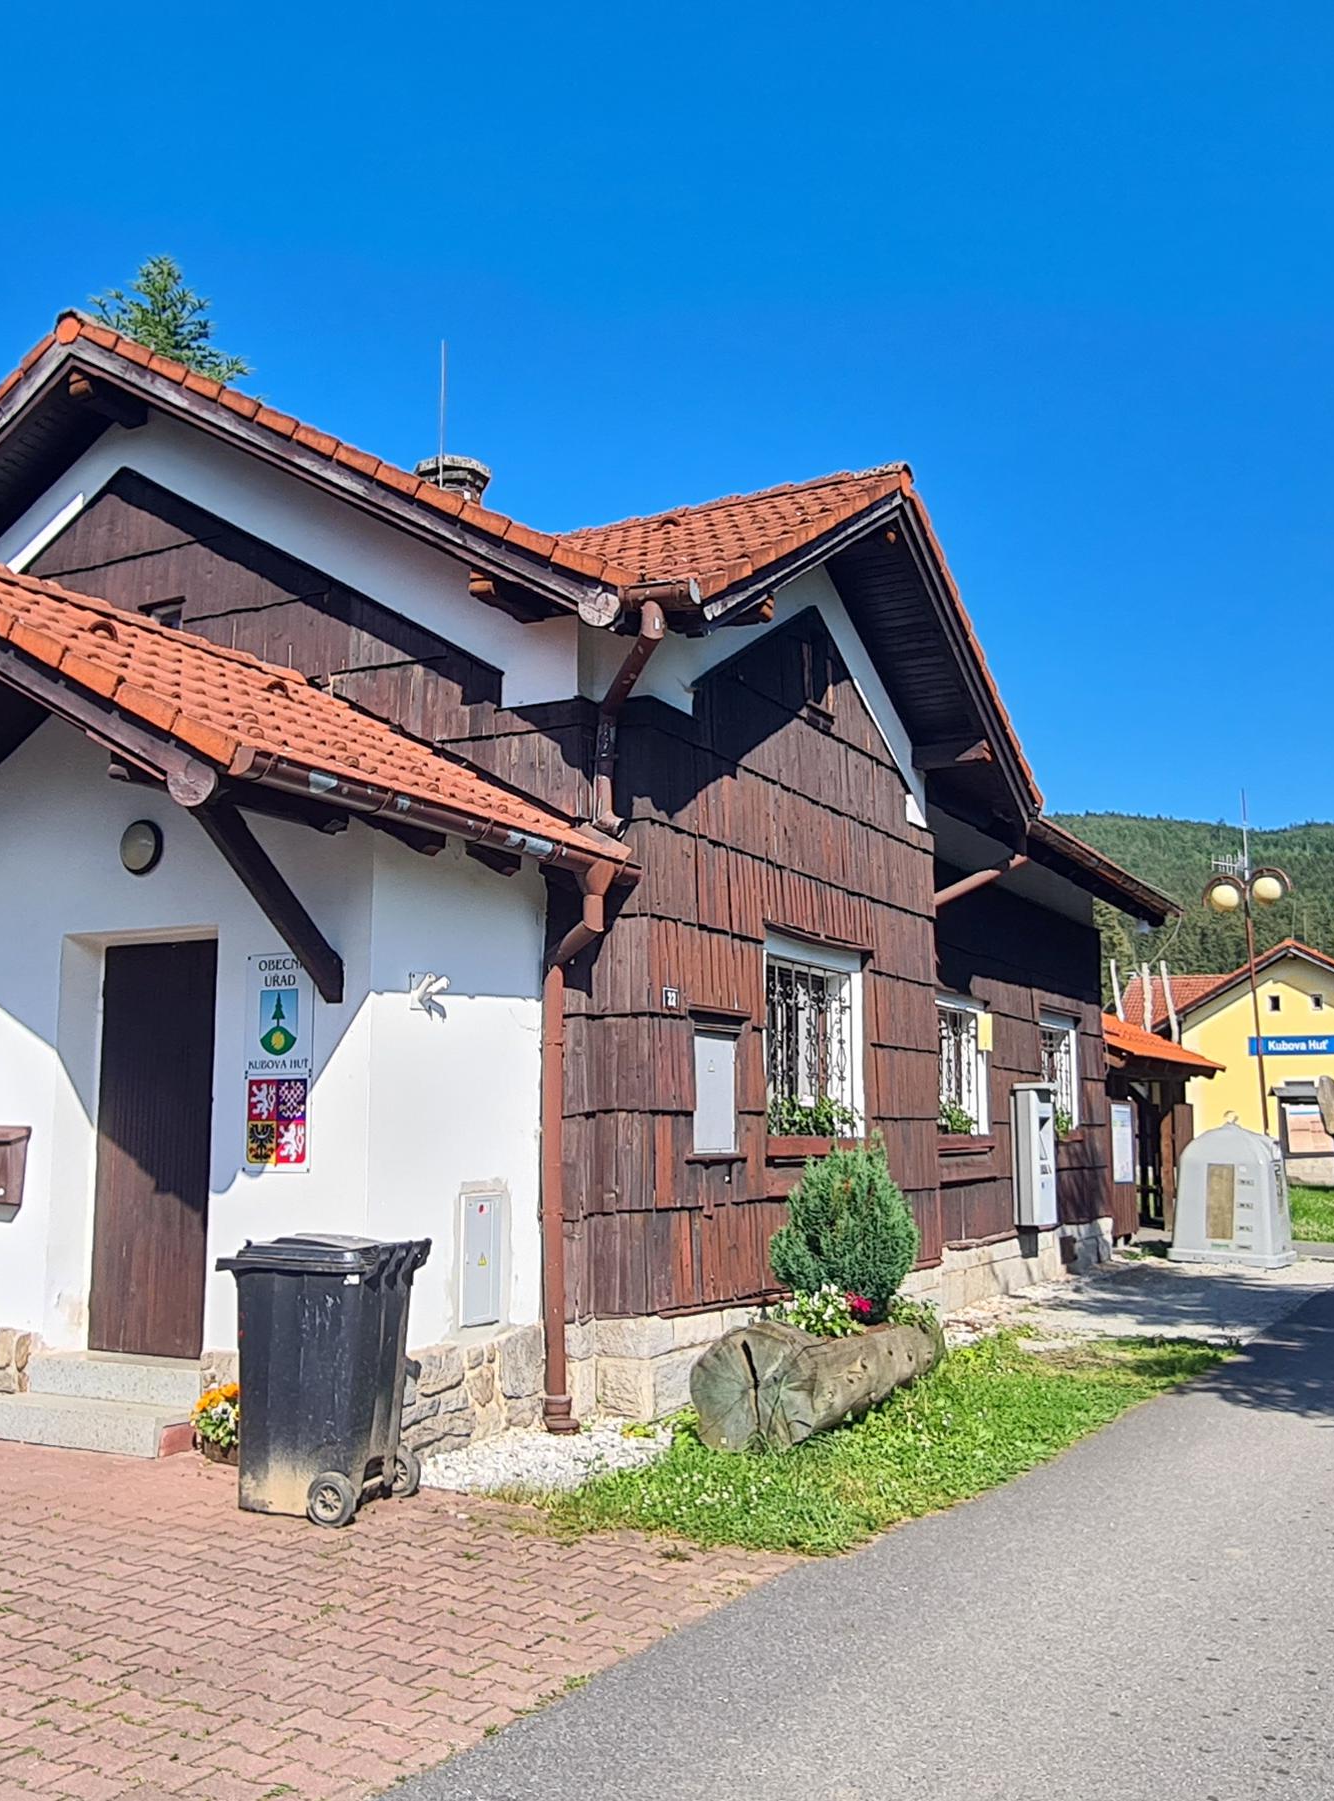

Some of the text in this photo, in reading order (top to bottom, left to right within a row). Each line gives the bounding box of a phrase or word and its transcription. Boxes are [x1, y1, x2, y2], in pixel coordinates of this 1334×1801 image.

[1268, 1039, 1329, 1051] Kubova Huť
[248, 1060, 287, 1070] KUBOVA
